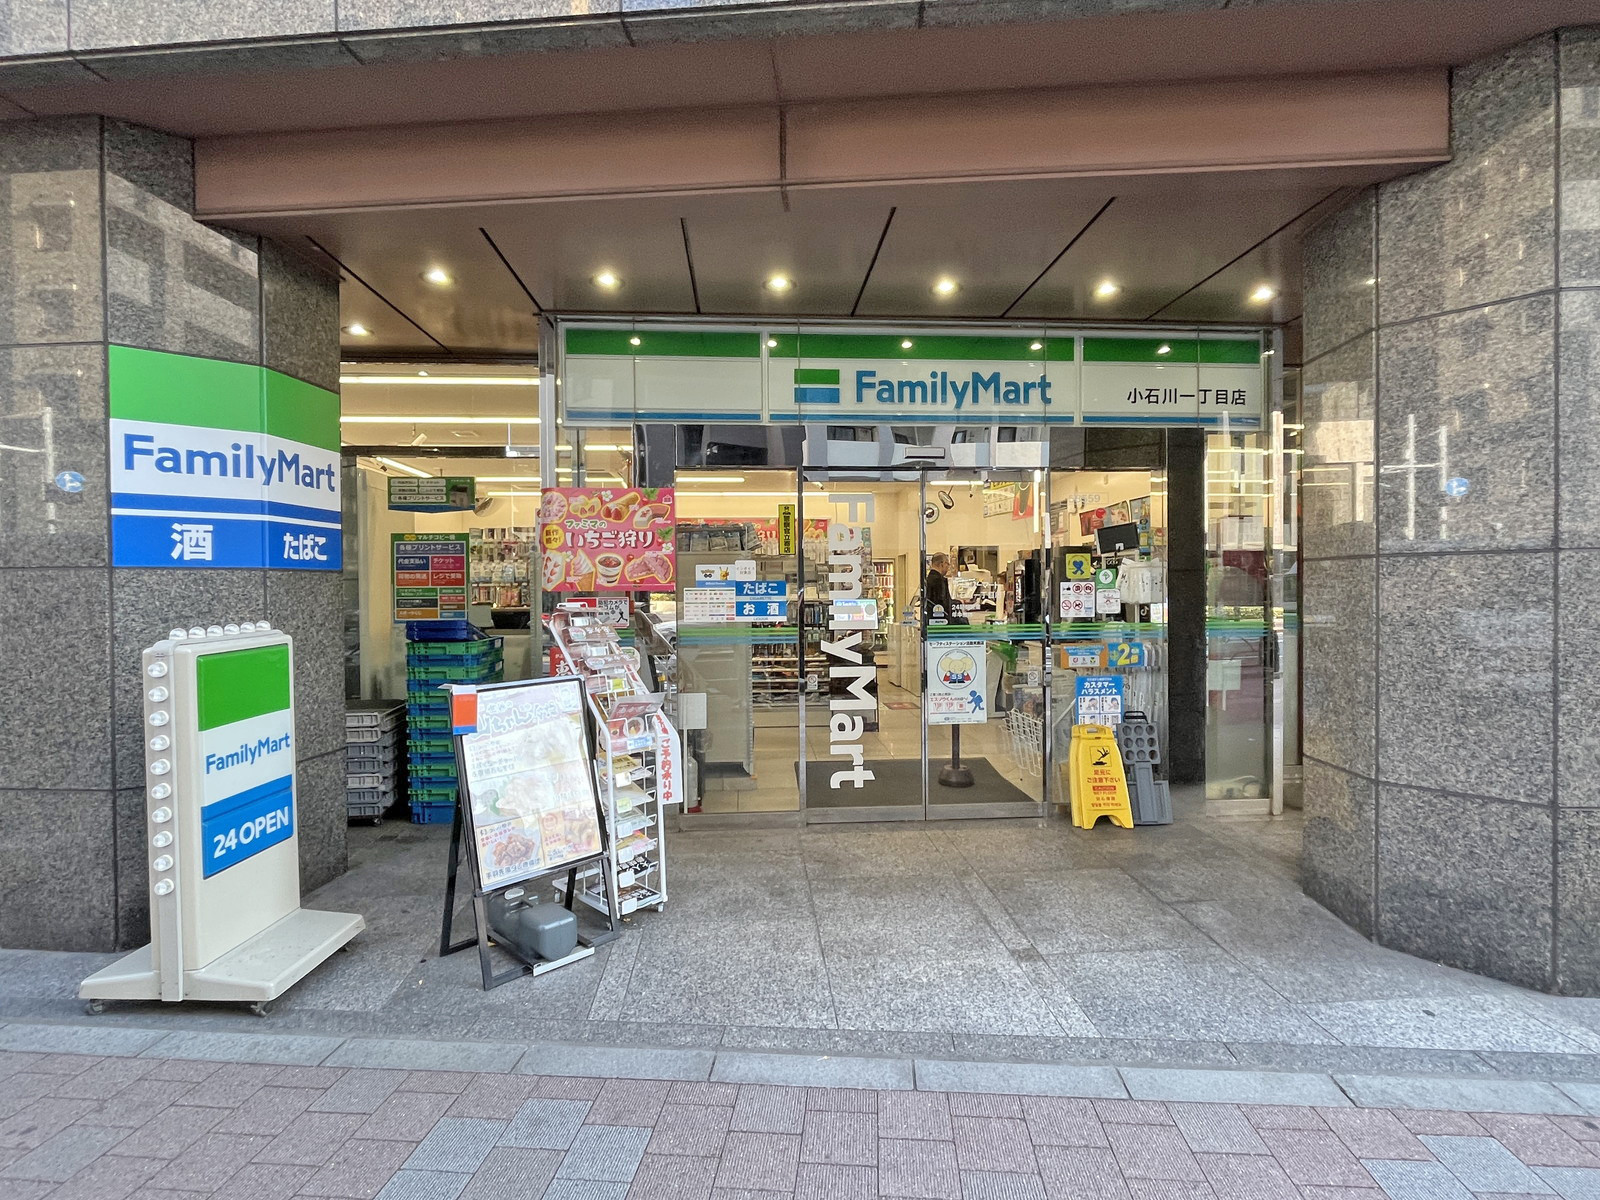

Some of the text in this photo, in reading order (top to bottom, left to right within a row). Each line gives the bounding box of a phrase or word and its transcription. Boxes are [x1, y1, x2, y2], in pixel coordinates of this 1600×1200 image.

[855, 371, 1052, 408] FamilyMart
[1126, 387, 1247, 406] 小石川一丁目店
[123, 432, 336, 493] FamilyMart
[170, 522, 214, 562] 酒
[565, 519, 607, 529] ファミマの
[565, 530, 653, 548] いちご狩り
[283, 532, 328, 562] たばこ
[743, 583, 779, 595] たばこ
[820, 493, 877, 789] FamilyMart
[205, 732, 291, 775] FamilyMart
[213, 806, 289, 859] 24 OPEN
